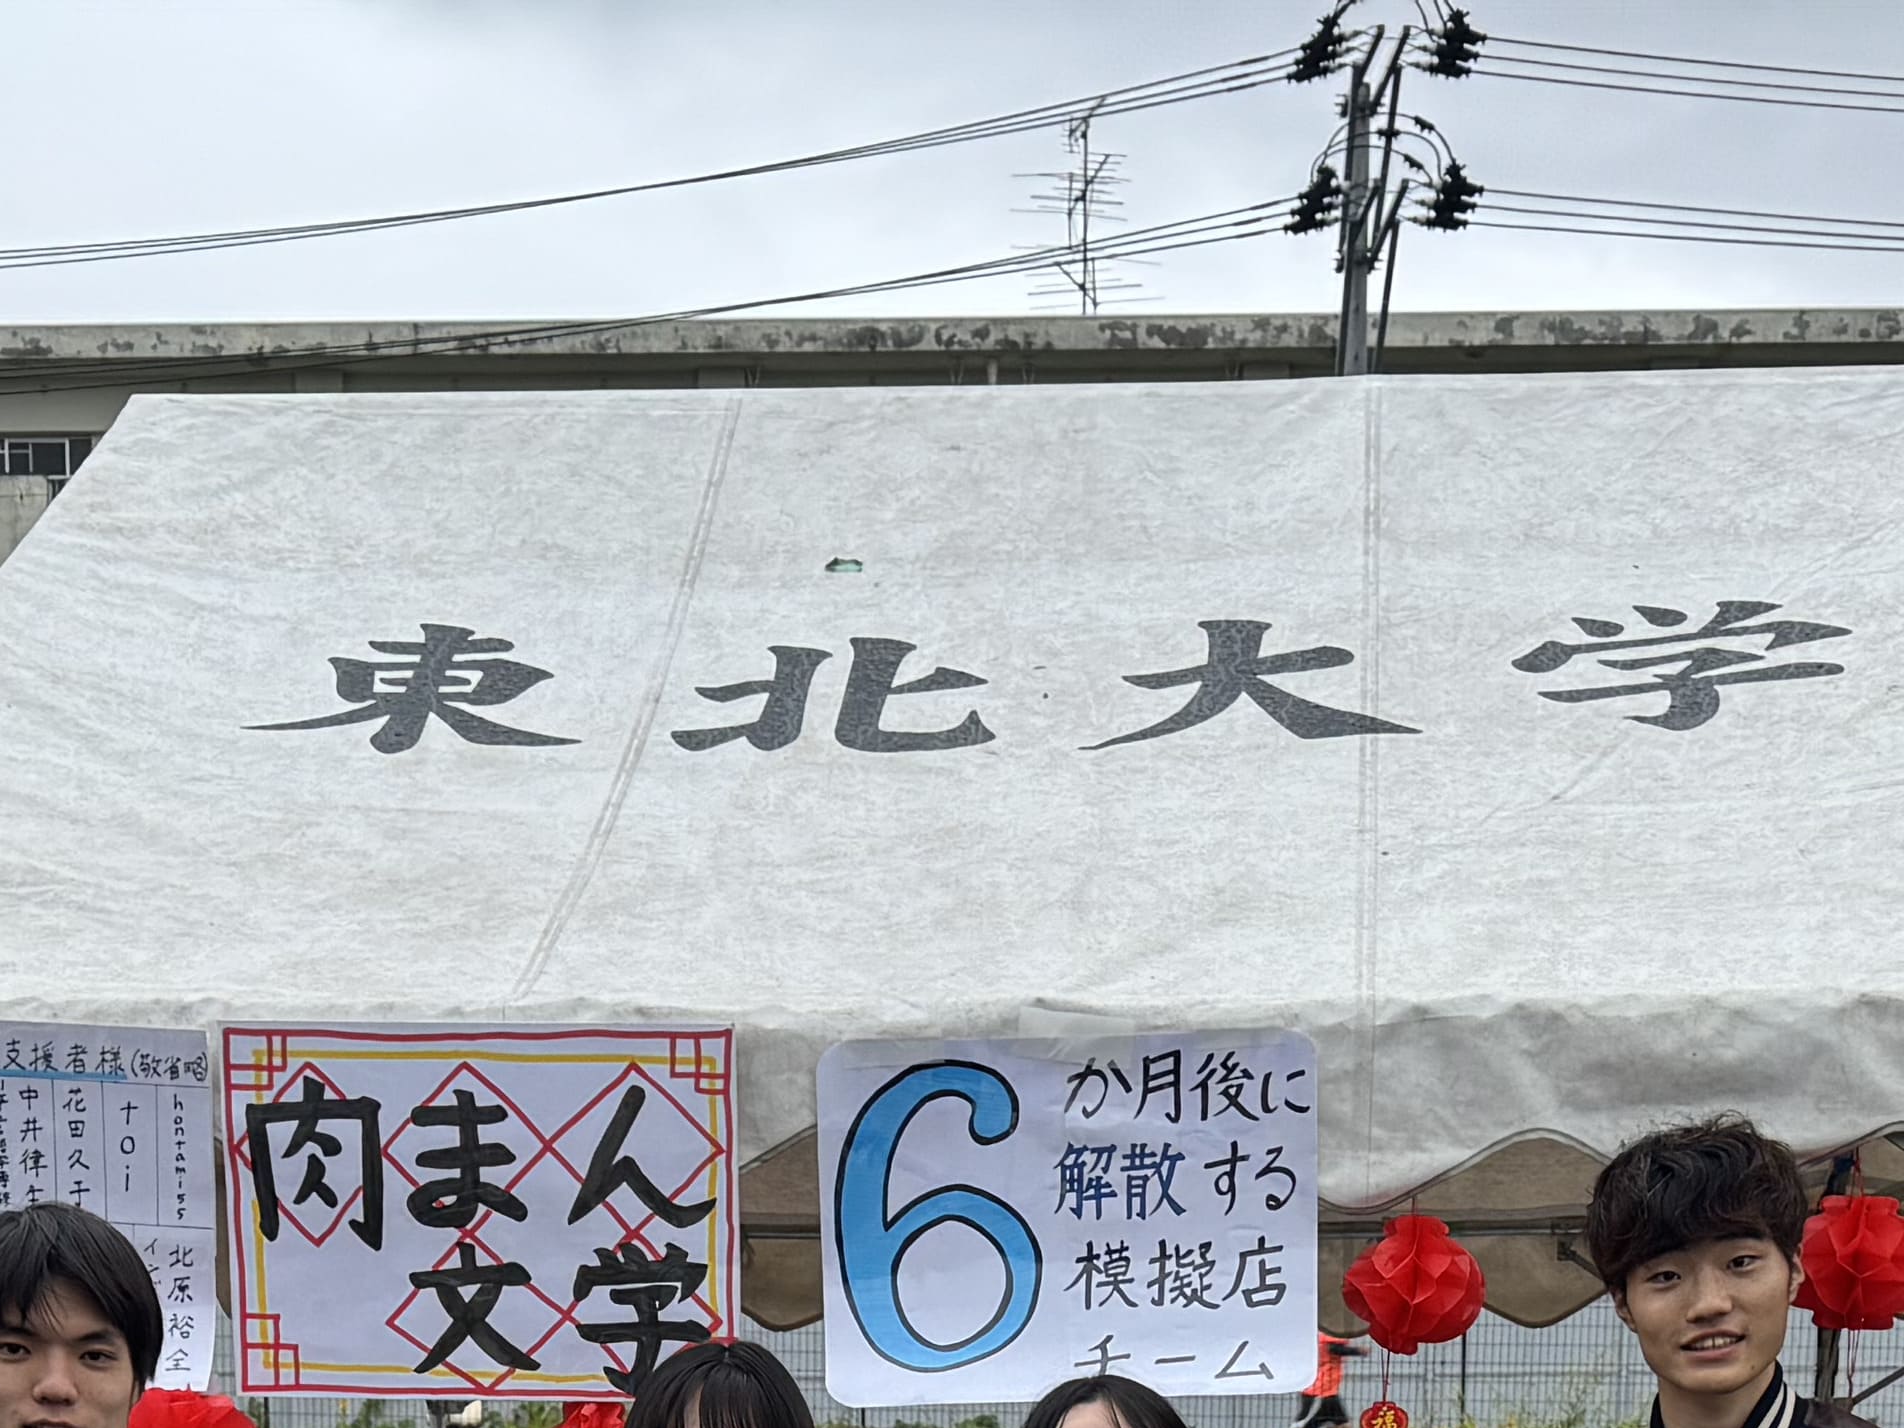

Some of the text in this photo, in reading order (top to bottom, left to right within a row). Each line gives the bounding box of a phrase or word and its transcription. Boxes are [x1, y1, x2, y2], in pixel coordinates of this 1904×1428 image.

[1063, 1048, 1311, 1124] か月後に
[245, 1076, 717, 1251] 肉まん
[1053, 1140, 1296, 1221] 解散する
[834, 1059, 1042, 1373] 6
[1063, 1236, 1288, 1312] 模擬店
[408, 1241, 713, 1394] 文学
[1074, 1334, 1274, 1380] チーム
